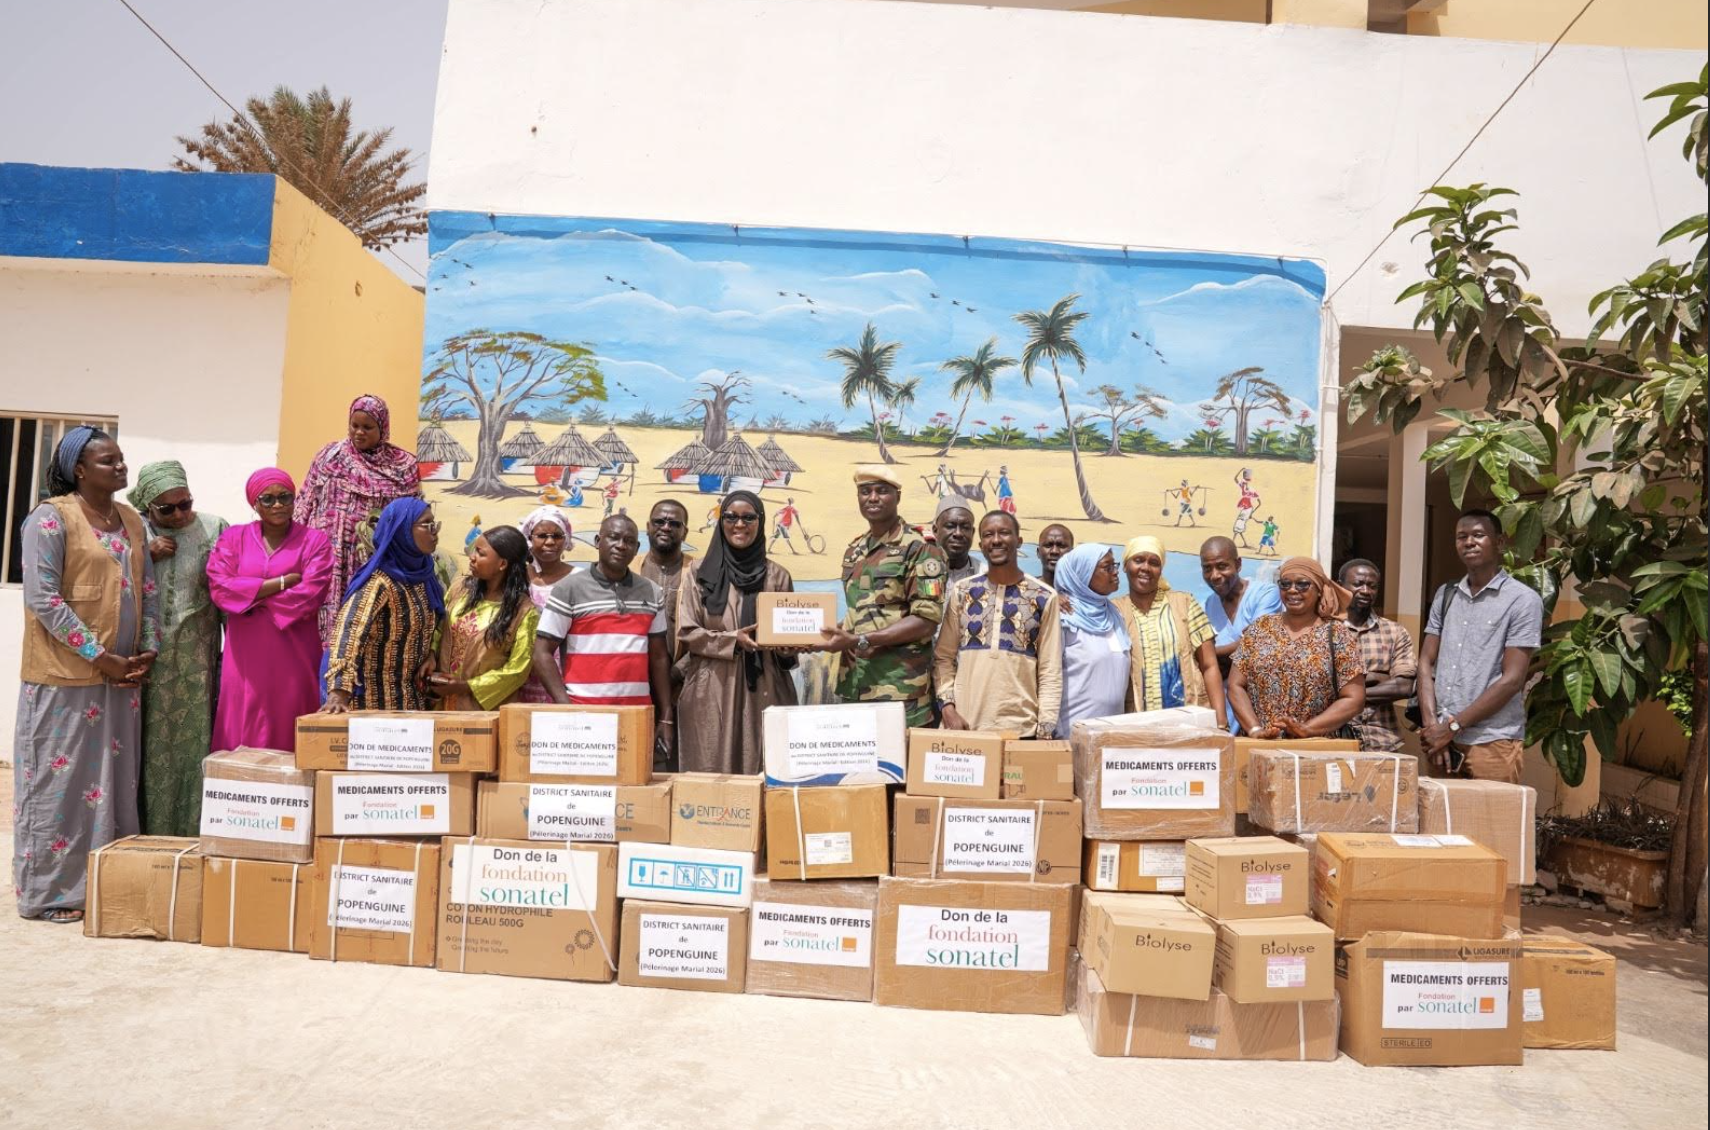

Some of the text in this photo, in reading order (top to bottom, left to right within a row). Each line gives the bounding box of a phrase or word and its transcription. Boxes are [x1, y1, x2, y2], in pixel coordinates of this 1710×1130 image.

[776, 598, 820, 608] Biolyse
[378, 744, 432, 754] MEDICAMENTS
[441, 744, 460, 754] 20G
[561, 742, 616, 750] MEDICAMENTS
[790, 742, 806, 750] DON
[931, 741, 983, 756] Biolyse
[1106, 761, 1217, 771] MEDICAMENTS OFFERTS
[934, 768, 975, 784] sonatel
[337, 785, 447, 795] MEDICAMENTS OFFERTS
[533, 788, 612, 798] DISTRICT SANITAIRE
[1131, 782, 1187, 797] sonatel
[205, 790, 309, 808] MEDICAMENTS OFFERTS
[344, 805, 418, 820] par sonatel
[697, 806, 751, 820] ENTRANCE
[948, 814, 1031, 824] DISTRICT SANITAIRE
[209, 814, 279, 830] par sonatel
[537, 815, 606, 826] POPENGUINE
[594, 832, 614, 840] 2026)
[954, 843, 1025, 853] POPENGUINE
[493, 848, 558, 863] Don de la
[1241, 860, 1292, 873] Biolyse
[482, 864, 567, 883] fondation
[371, 876, 414, 886] SANITAIRE
[480, 883, 568, 907] sonatel
[337, 899, 406, 914] POPENGUINE
[485, 905, 553, 918] HYDROPHILE
[369, 918, 391, 926] Marial
[393, 920, 412, 928] 2026)
[499, 918, 524, 928] 500G
[759, 912, 871, 929] MEDICAMENTS OFFERTS
[941, 909, 1008, 924] Don de la
[643, 921, 725, 932] DISTRICT SANITAIRE
[928, 925, 1018, 944] fondation
[764, 936, 840, 952] par sonatel
[1135, 934, 1192, 952] Biolyse
[1261, 941, 1315, 955] Biolyse
[648, 948, 718, 960] POPENGUINE
[926, 945, 1019, 968] sonatel
[706, 967, 725, 975] 2026)
[1391, 974, 1508, 986] MEDICAMENTS OFFERTS
[1418, 992, 1456, 1000] Fondation
[1397, 997, 1477, 1014] par sonatel
